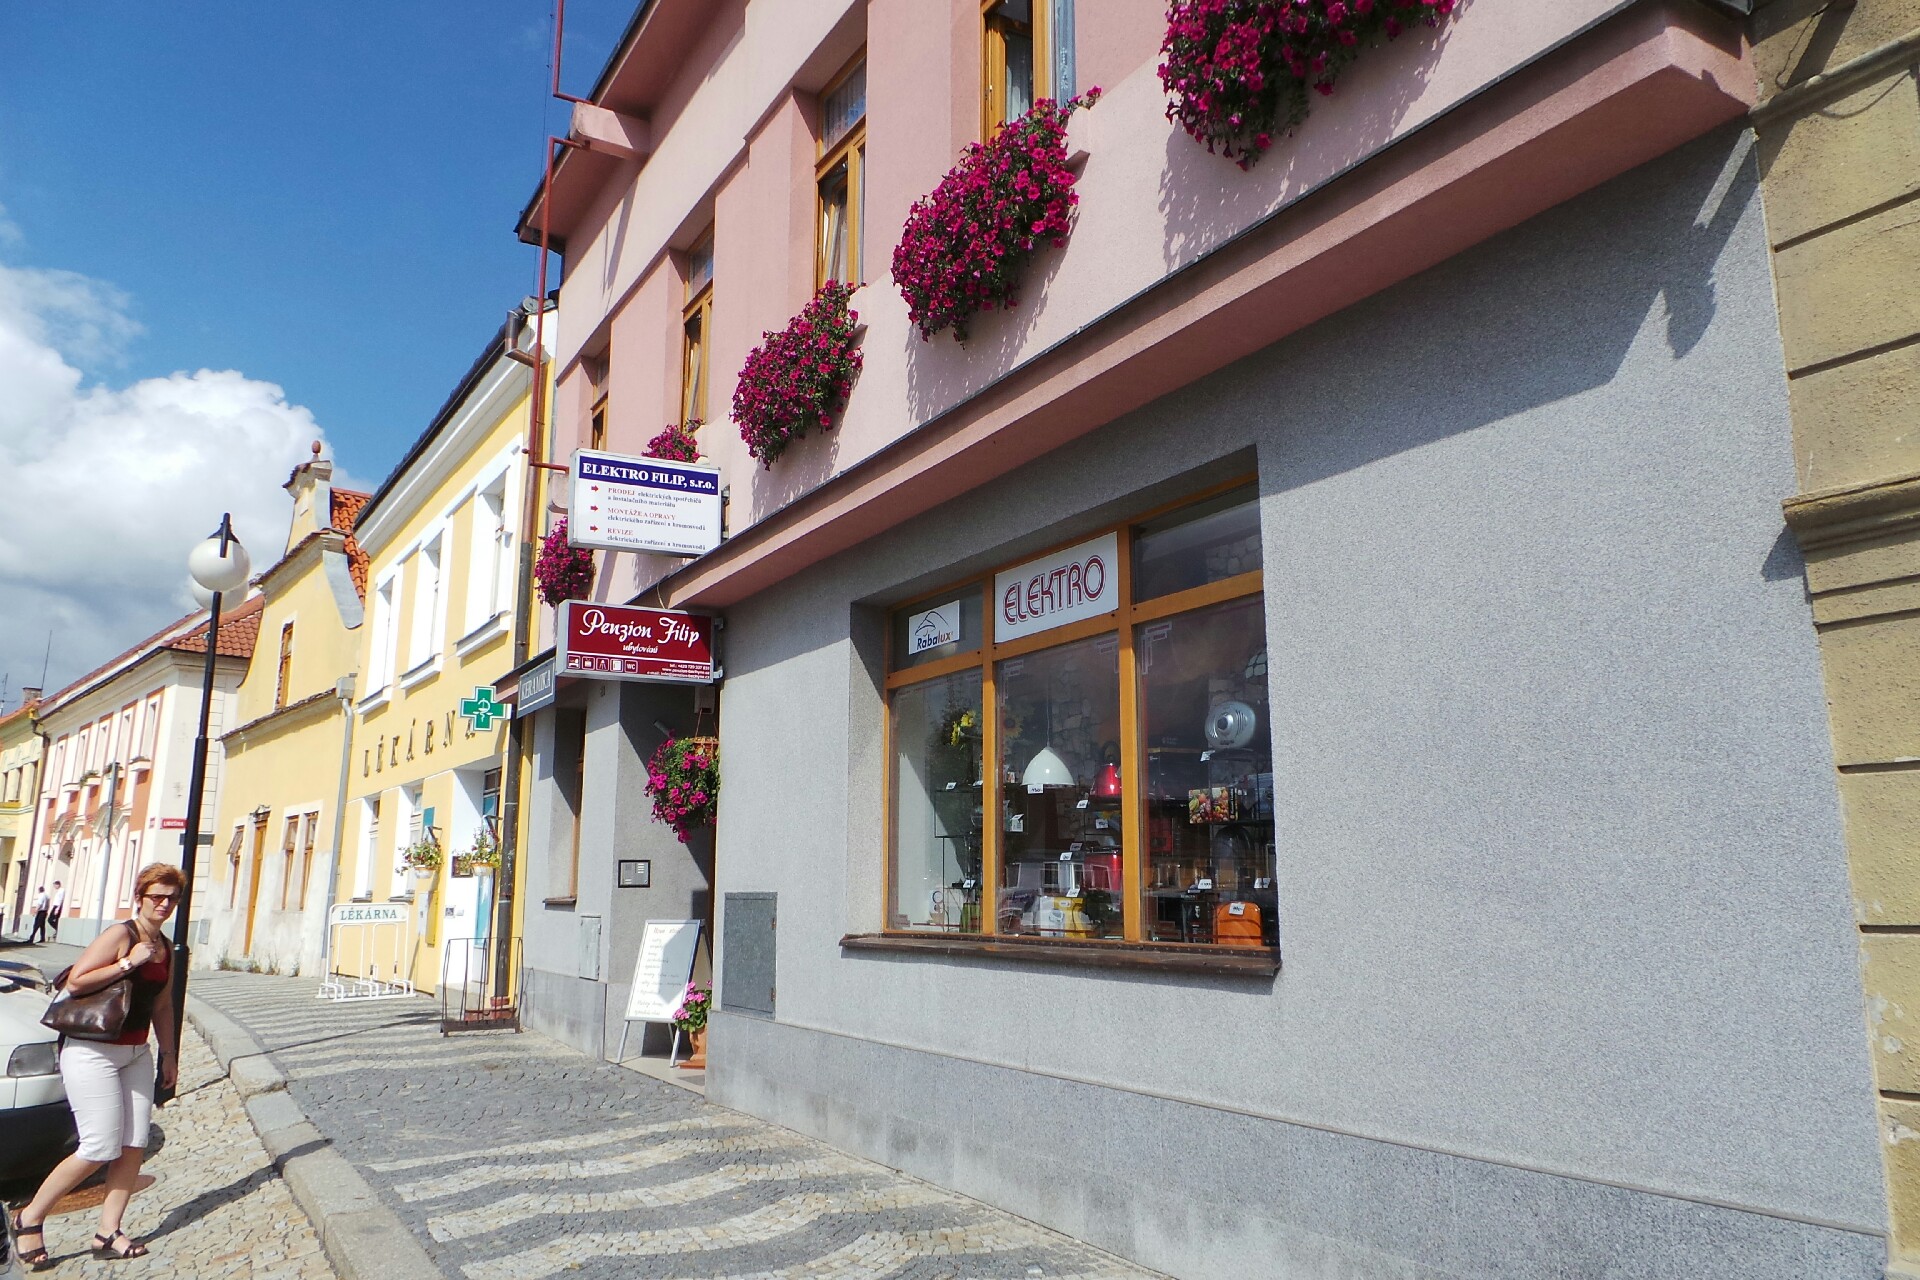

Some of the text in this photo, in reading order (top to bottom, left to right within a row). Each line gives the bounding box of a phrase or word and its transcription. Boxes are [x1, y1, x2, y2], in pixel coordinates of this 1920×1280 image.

[582, 462, 716, 490] ELEKTRO FILIP, s.r.o.
[608, 487, 635, 497] PRODEJ
[608, 507, 643, 517] MONTÁŽE
[650, 512, 676, 521] OPRAVY
[607, 527, 634, 536] REVIZE
[1003, 554, 1106, 625] ELEKTRO
[579, 609, 700, 648] Penzion Filip
[622, 641, 659, 654] ubytování
[916, 630, 951, 651] Rabalux
[363, 710, 476, 778] LÉKÁRNA
[340, 907, 398, 921] LÉKÁRNA
